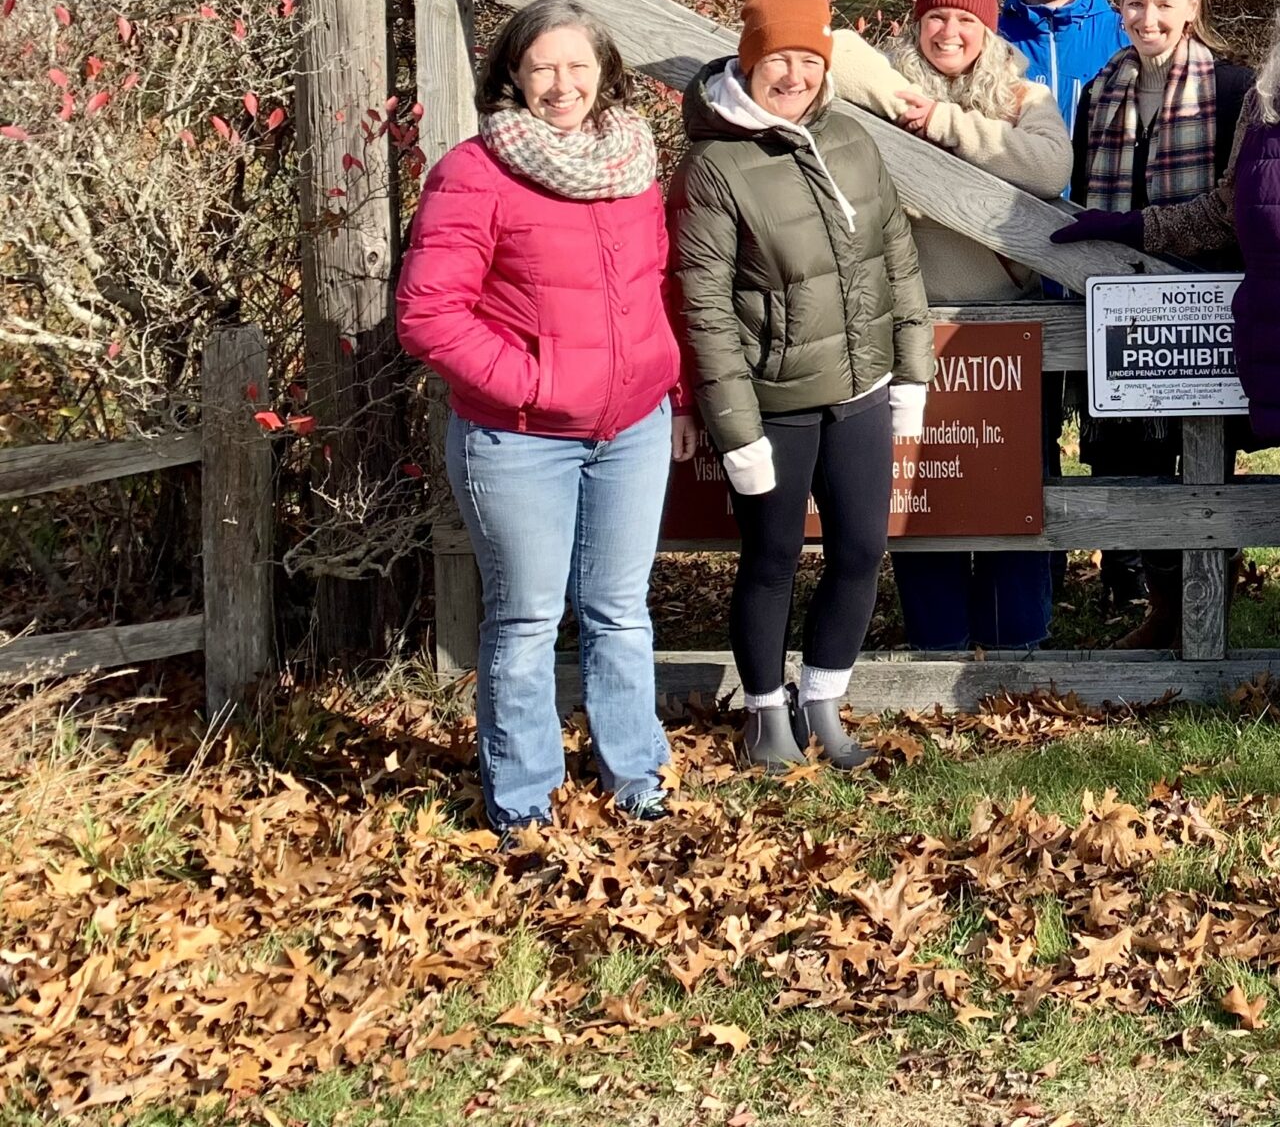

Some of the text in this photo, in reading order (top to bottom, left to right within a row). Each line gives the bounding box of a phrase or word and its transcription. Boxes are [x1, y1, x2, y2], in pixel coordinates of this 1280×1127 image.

[1162, 291, 1224, 304] NOTICE
[1105, 307, 1123, 315] THIS
[1125, 306, 1167, 314] PROPERTY
[1203, 305, 1214, 313] TO
[1216, 305, 1232, 313] THE
[1124, 314, 1175, 322] FREQUENTLY
[1177, 313, 1199, 321] USED
[1127, 325, 1232, 345] HUNTING
[1122, 348, 1236, 367] PROHIBIT
[927, 356, 1022, 392] RVATION
[1135, 369, 1166, 377] PENALTY
[1180, 368, 1193, 376] THE
[983, 419, 1005, 444] Inc.
[903, 456, 915, 478] to
[918, 455, 963, 478] sunset.
